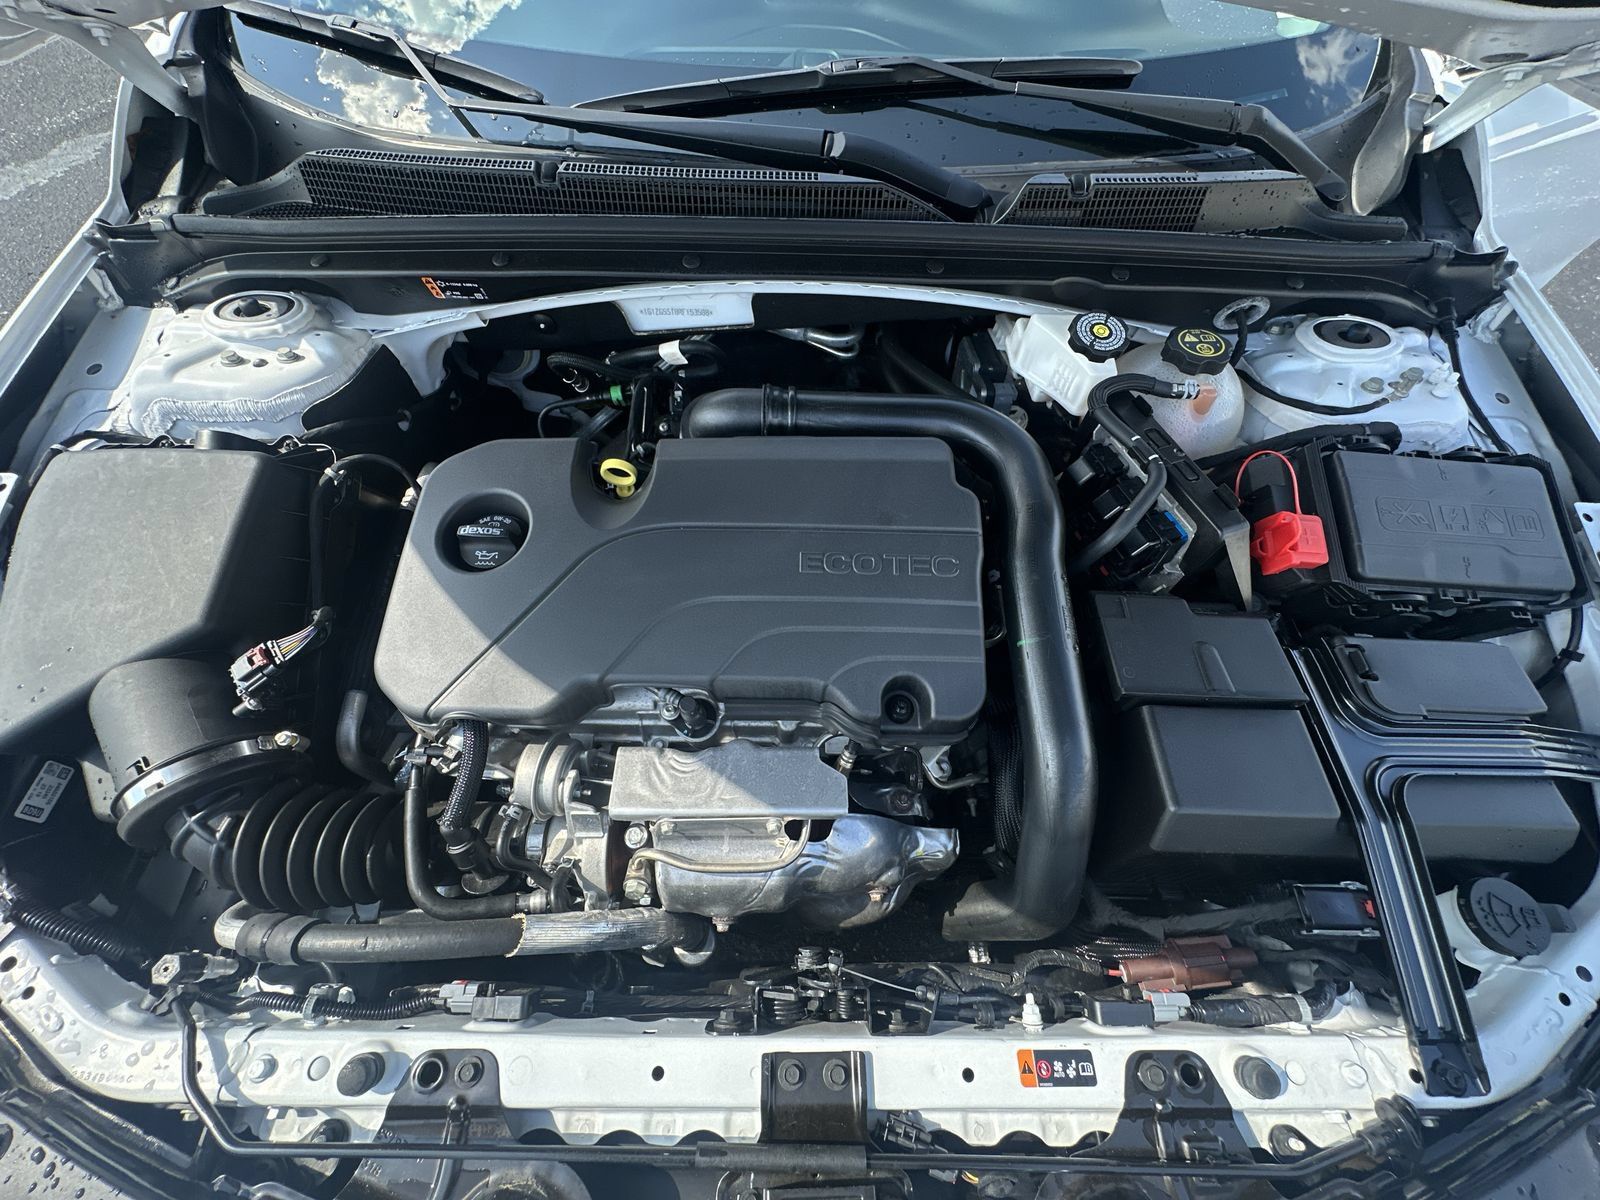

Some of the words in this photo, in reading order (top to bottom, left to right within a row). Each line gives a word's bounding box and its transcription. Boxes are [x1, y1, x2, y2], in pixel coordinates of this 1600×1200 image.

[479, 516, 491, 524] SAE
[460, 525, 501, 536] dexos
[799, 551, 960, 577] ECOTEC
